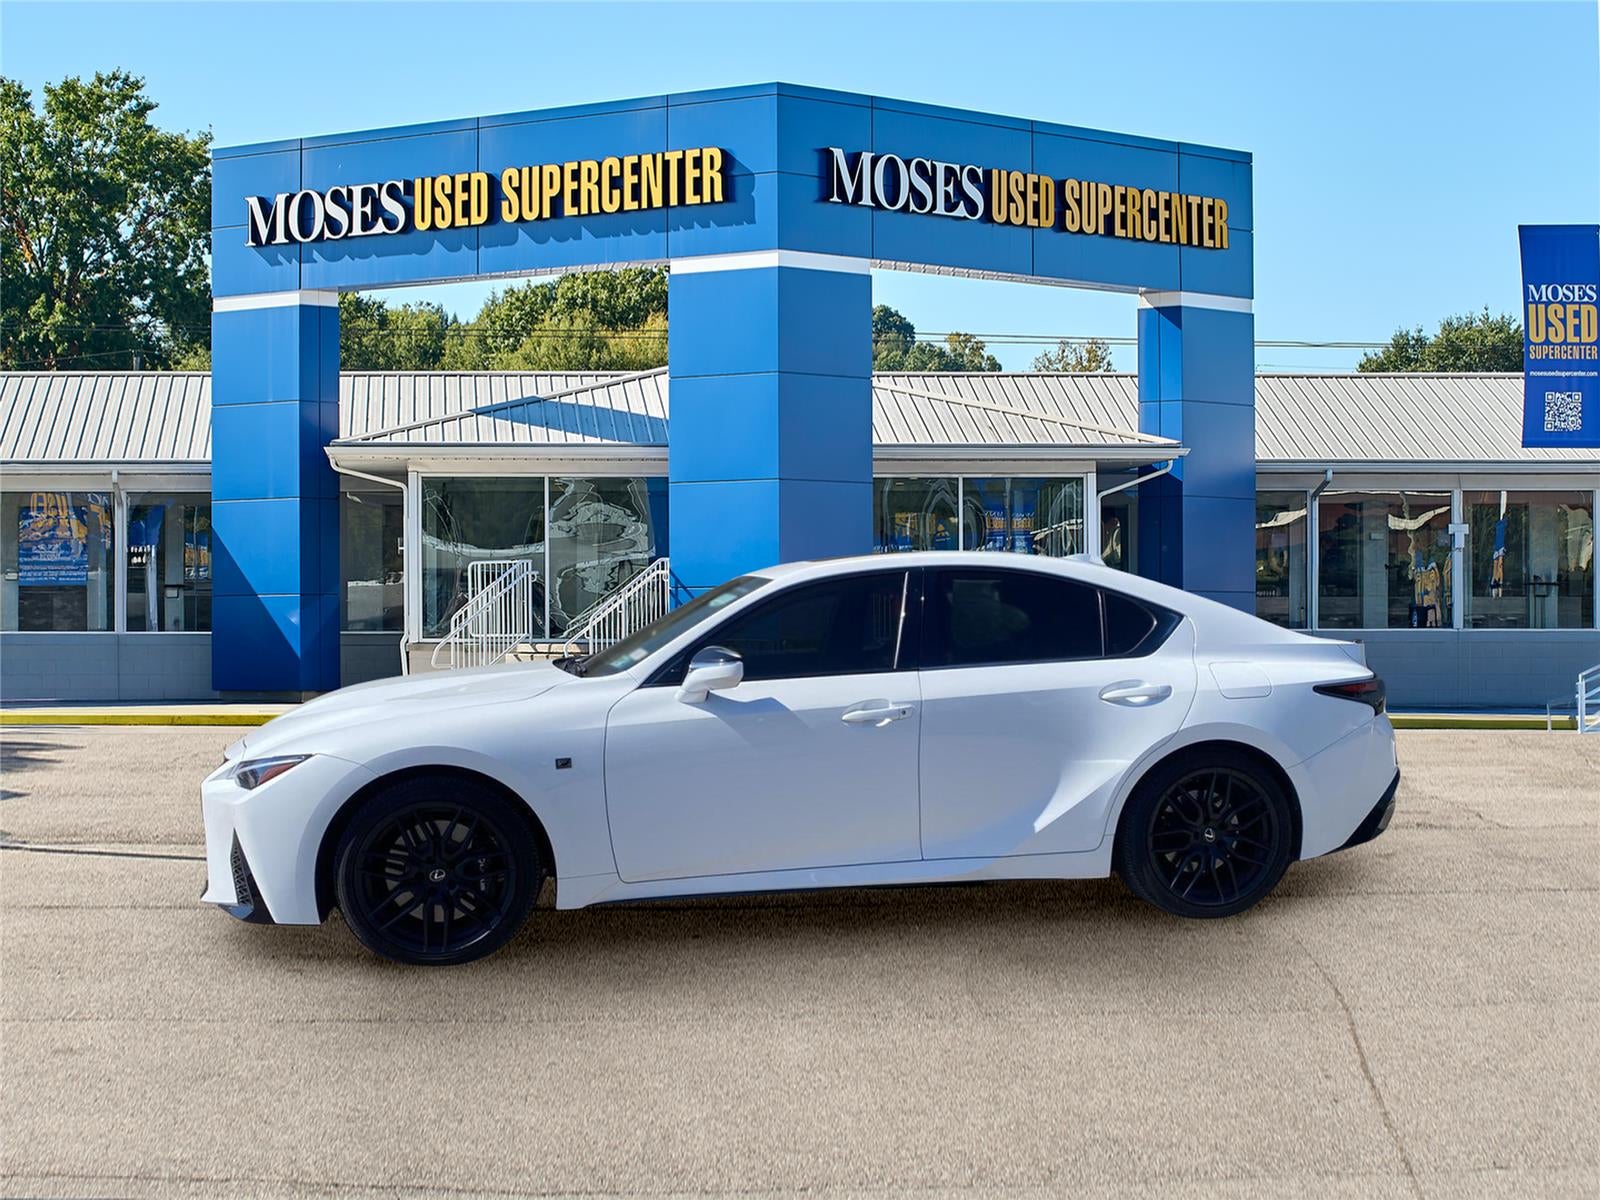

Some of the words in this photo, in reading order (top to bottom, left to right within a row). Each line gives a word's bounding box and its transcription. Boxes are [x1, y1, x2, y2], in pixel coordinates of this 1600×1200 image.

[245, 180, 406, 247] MOSES
[413, 172, 489, 231] USED
[500, 147, 724, 223] SUPERCENTER
[828, 146, 985, 220] MOSES
[991, 168, 1055, 228] USED
[1065, 178, 1230, 249] SUPERCENTER
[1528, 284, 1597, 302] MOSES
[1528, 304, 1598, 343] USED
[1530, 345, 1598, 360] SUPERCENTER
